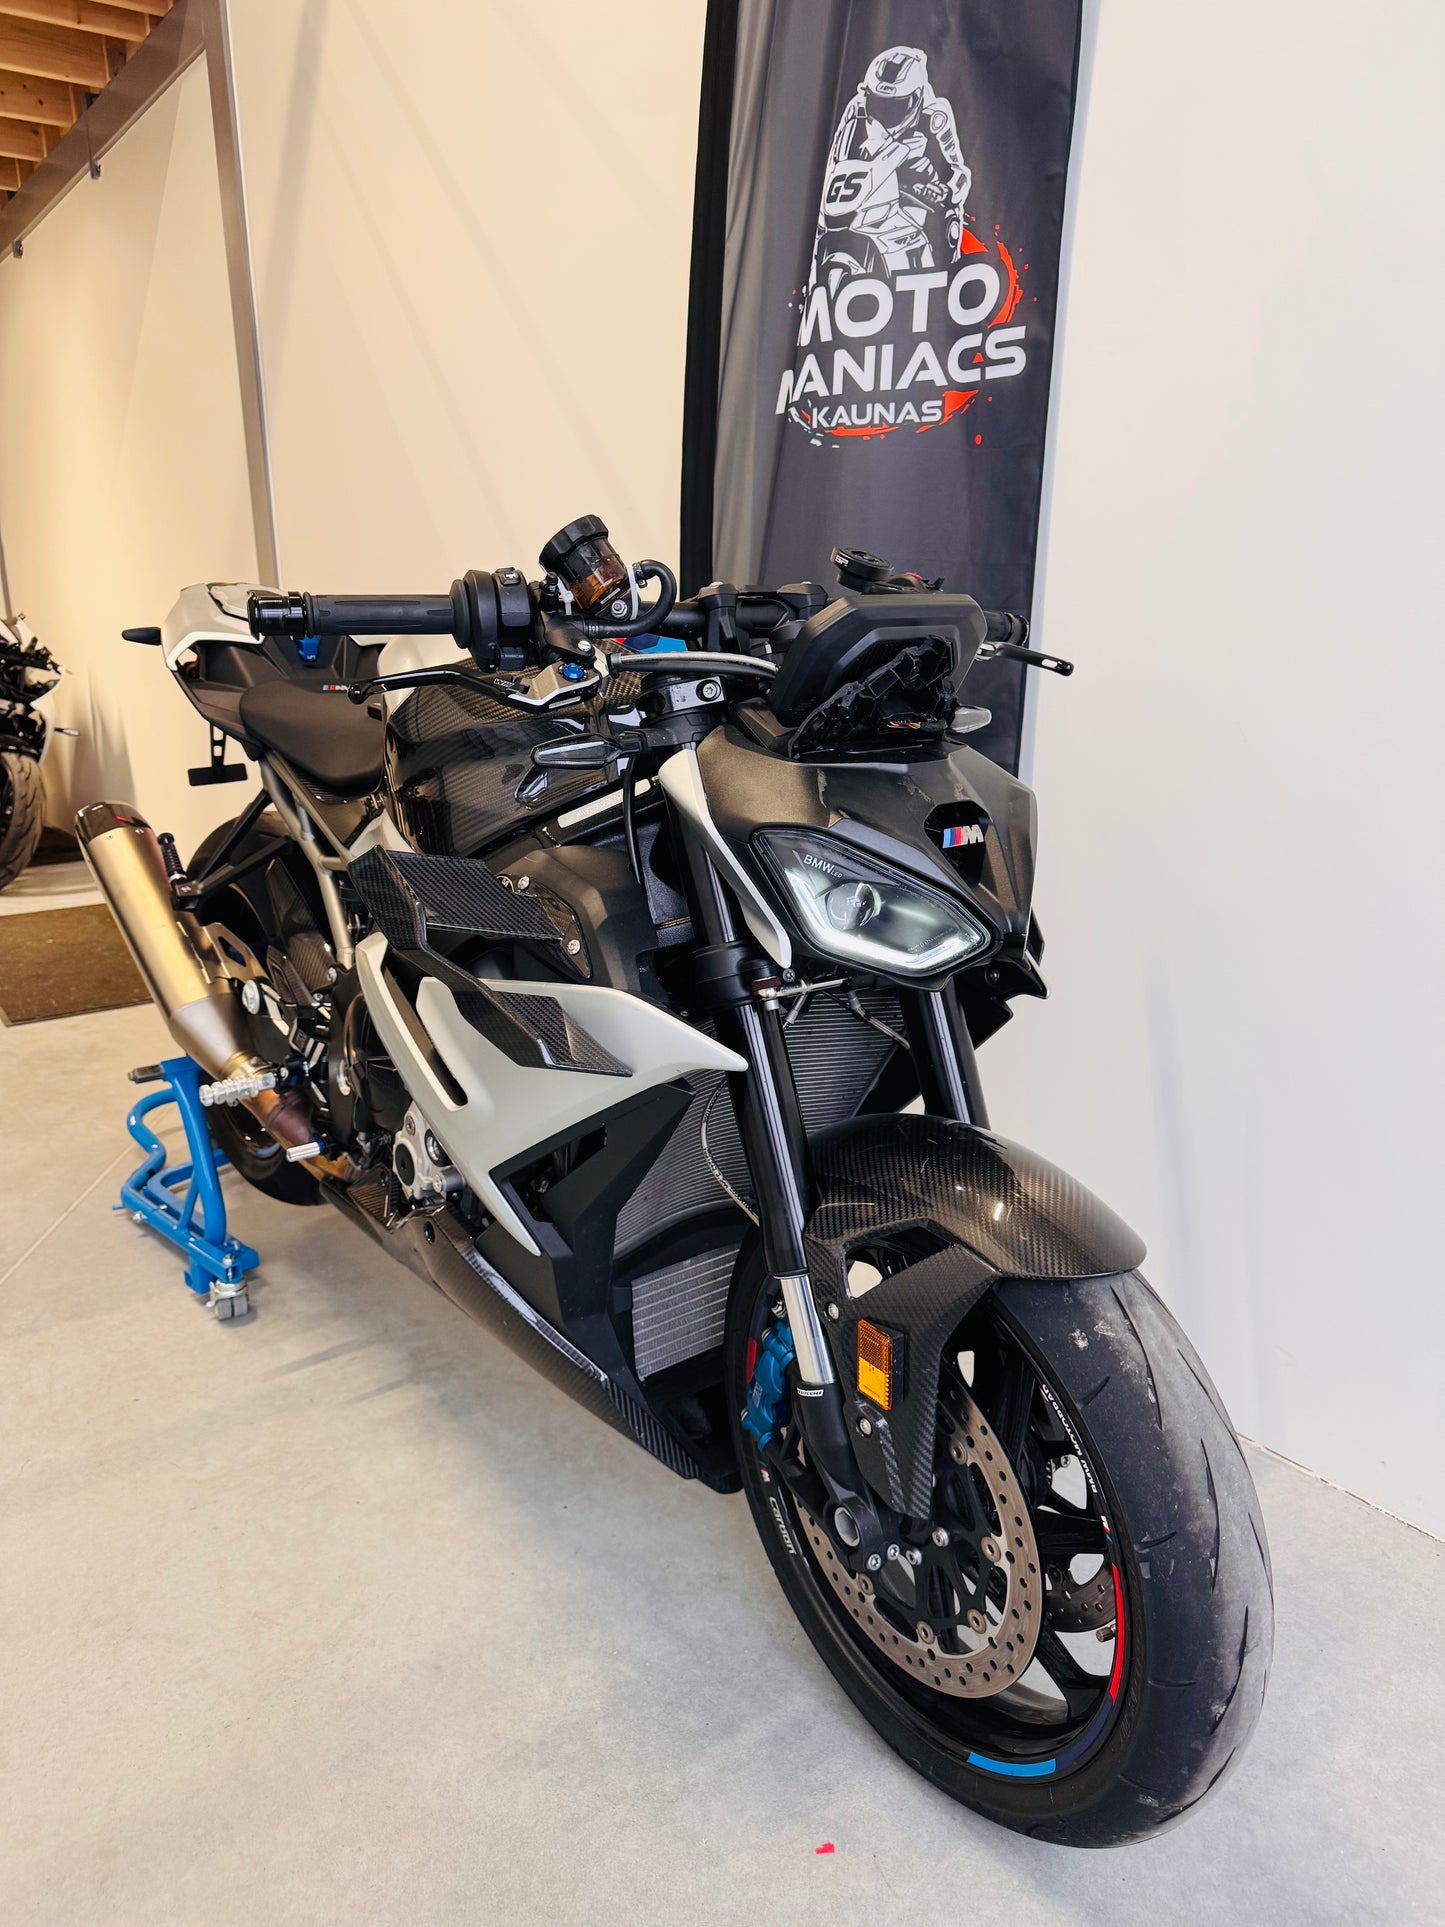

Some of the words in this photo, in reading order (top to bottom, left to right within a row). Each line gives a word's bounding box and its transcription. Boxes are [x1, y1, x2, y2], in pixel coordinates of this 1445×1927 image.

[826, 171, 869, 204] GS
[797, 263, 1000, 347] MOTO
[812, 400, 943, 428] KAUNAS
[803, 854, 835, 874] BMW
